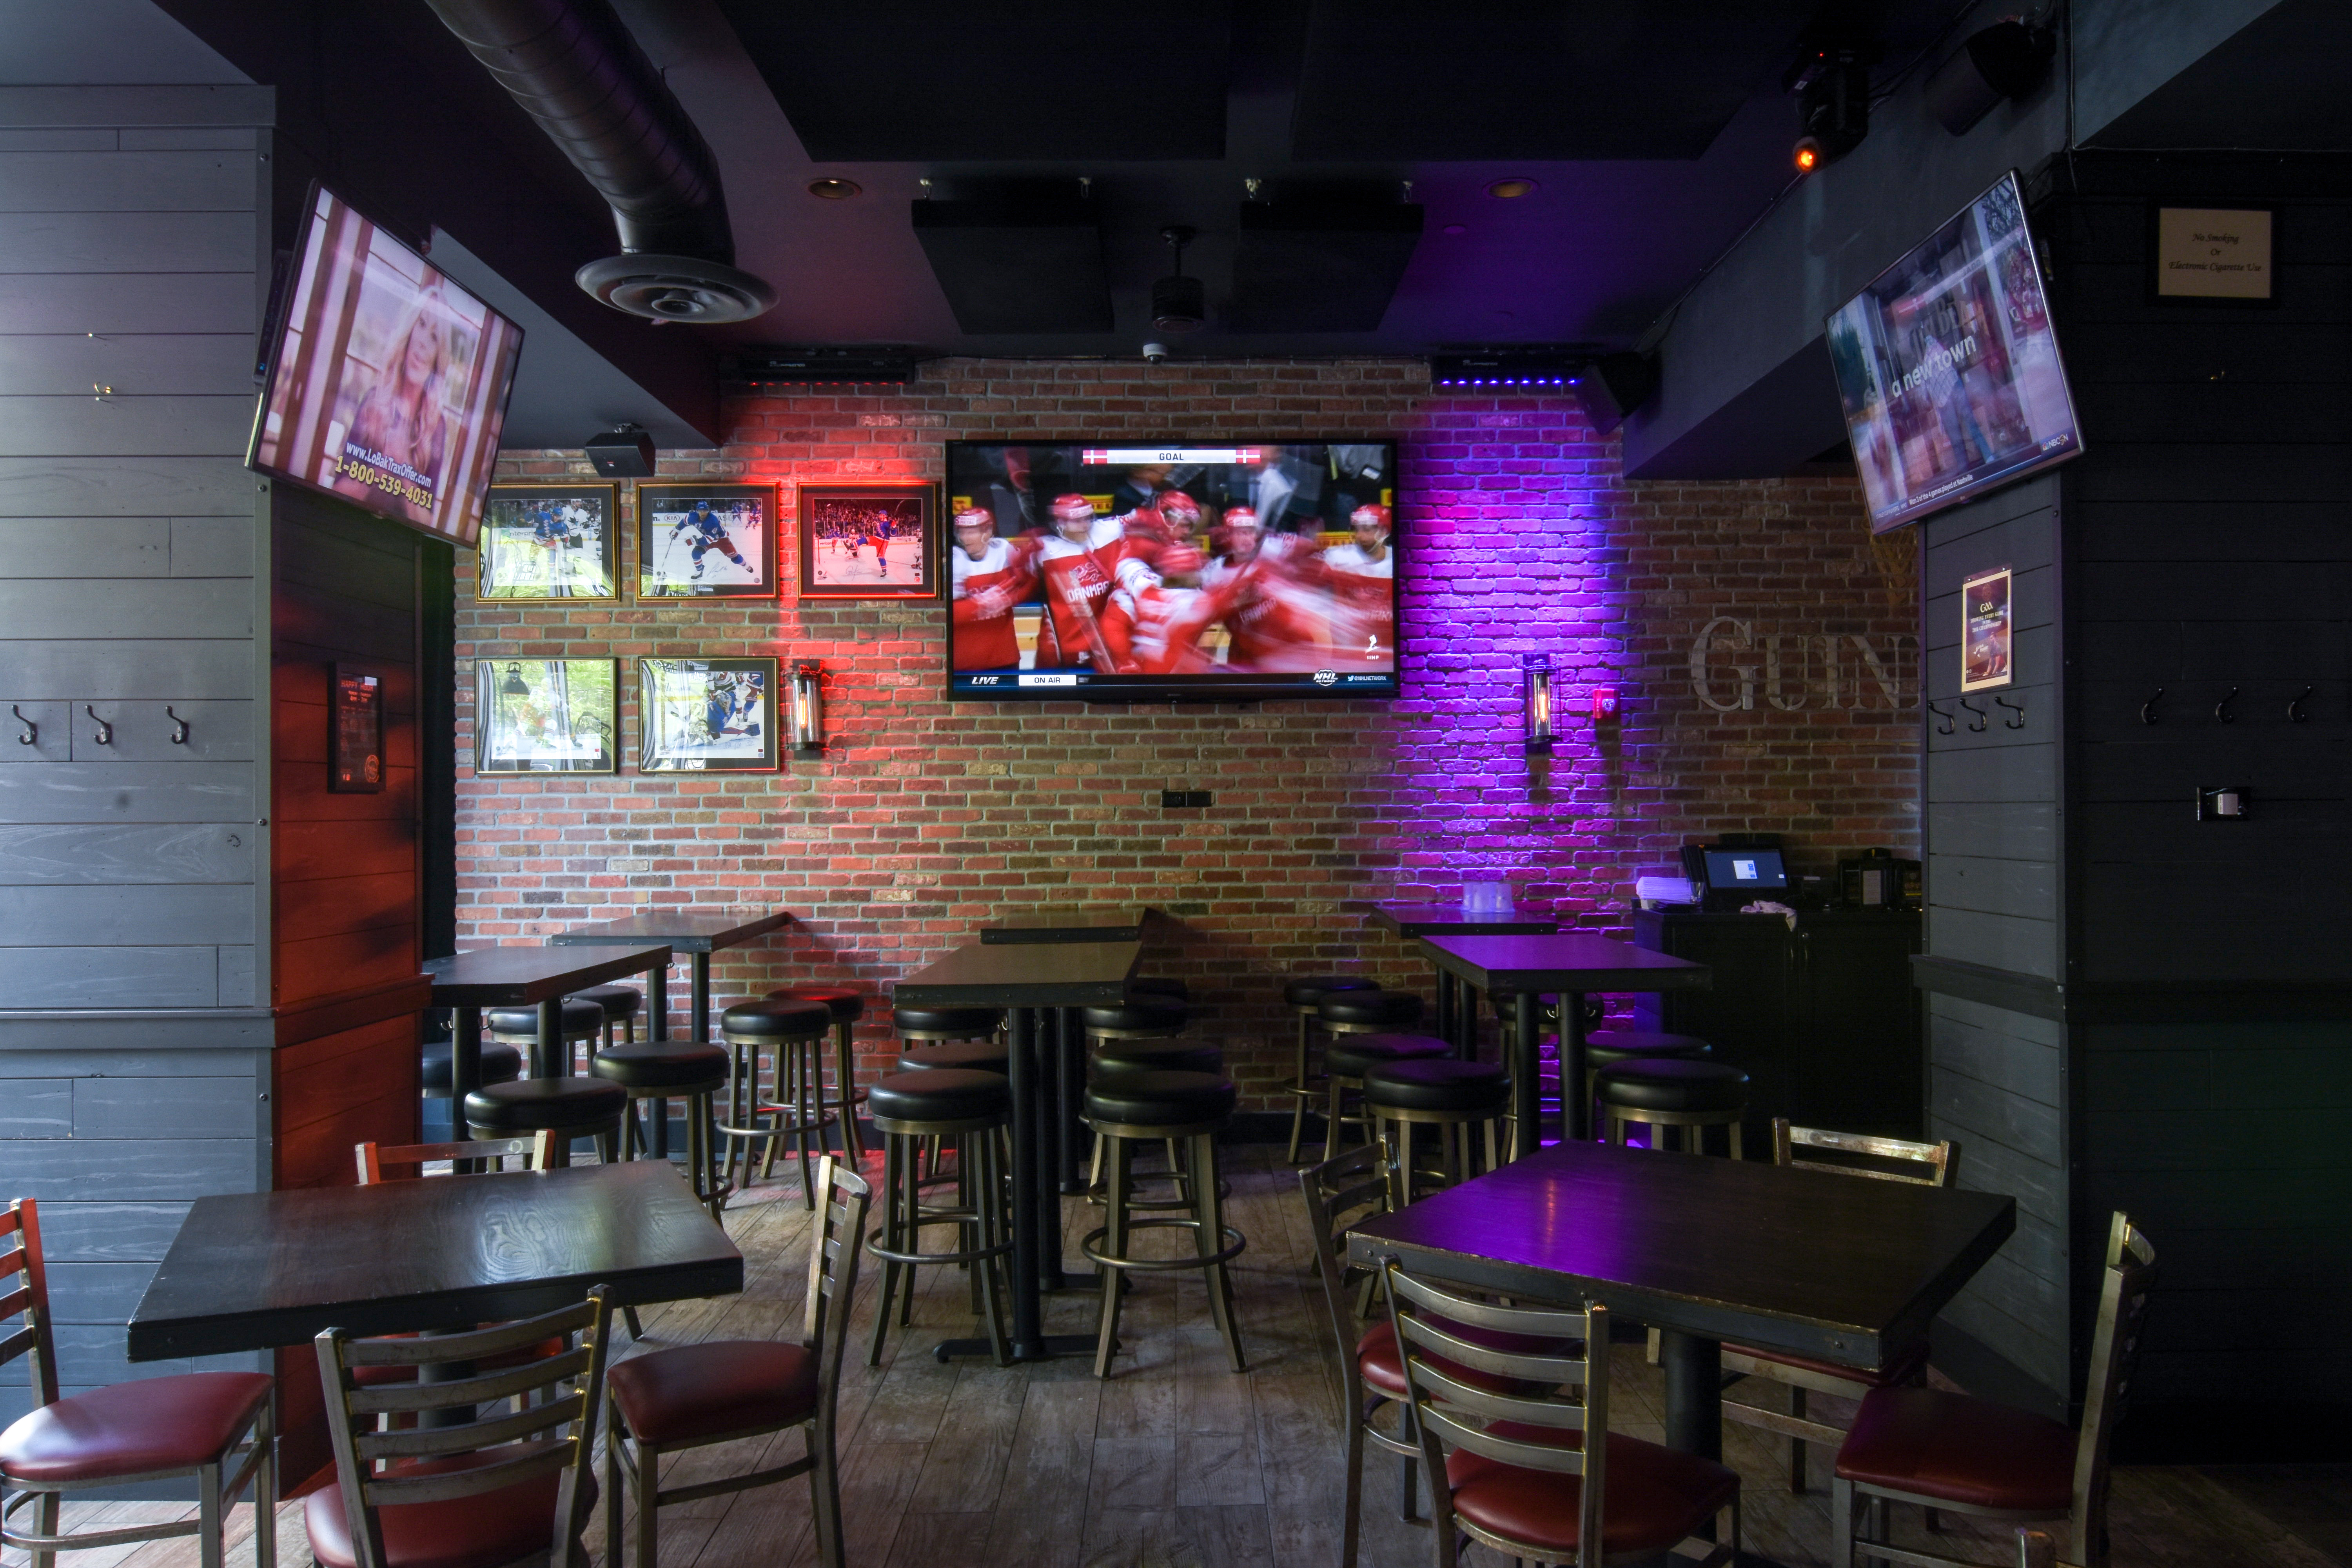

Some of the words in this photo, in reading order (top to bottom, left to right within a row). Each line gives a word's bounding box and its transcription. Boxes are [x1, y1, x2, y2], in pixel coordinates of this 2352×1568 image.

[2206, 233, 2239, 244] Smoking
[2169, 261, 2208, 270] Electronic
[2210, 262, 2244, 273] Cigarette
[1892, 380, 1901, 397] a
[1903, 359, 1932, 391] new
[1935, 336, 1976, 371] town
[347, 442, 432, 488] www.LoBakTraxOffer.com
[335, 456, 433, 509] 1-800-539-4031
[1931, 488, 1942, 498] games
[1942, 482, 1953, 494] played
[1957, 474, 1973, 486] Nashville
[1067, 581, 1109, 602] DANMAR
[1980, 601, 1993, 613] GAA
[1690, 616, 1920, 711] GUIN
[971, 677, 999, 685] LIVE
